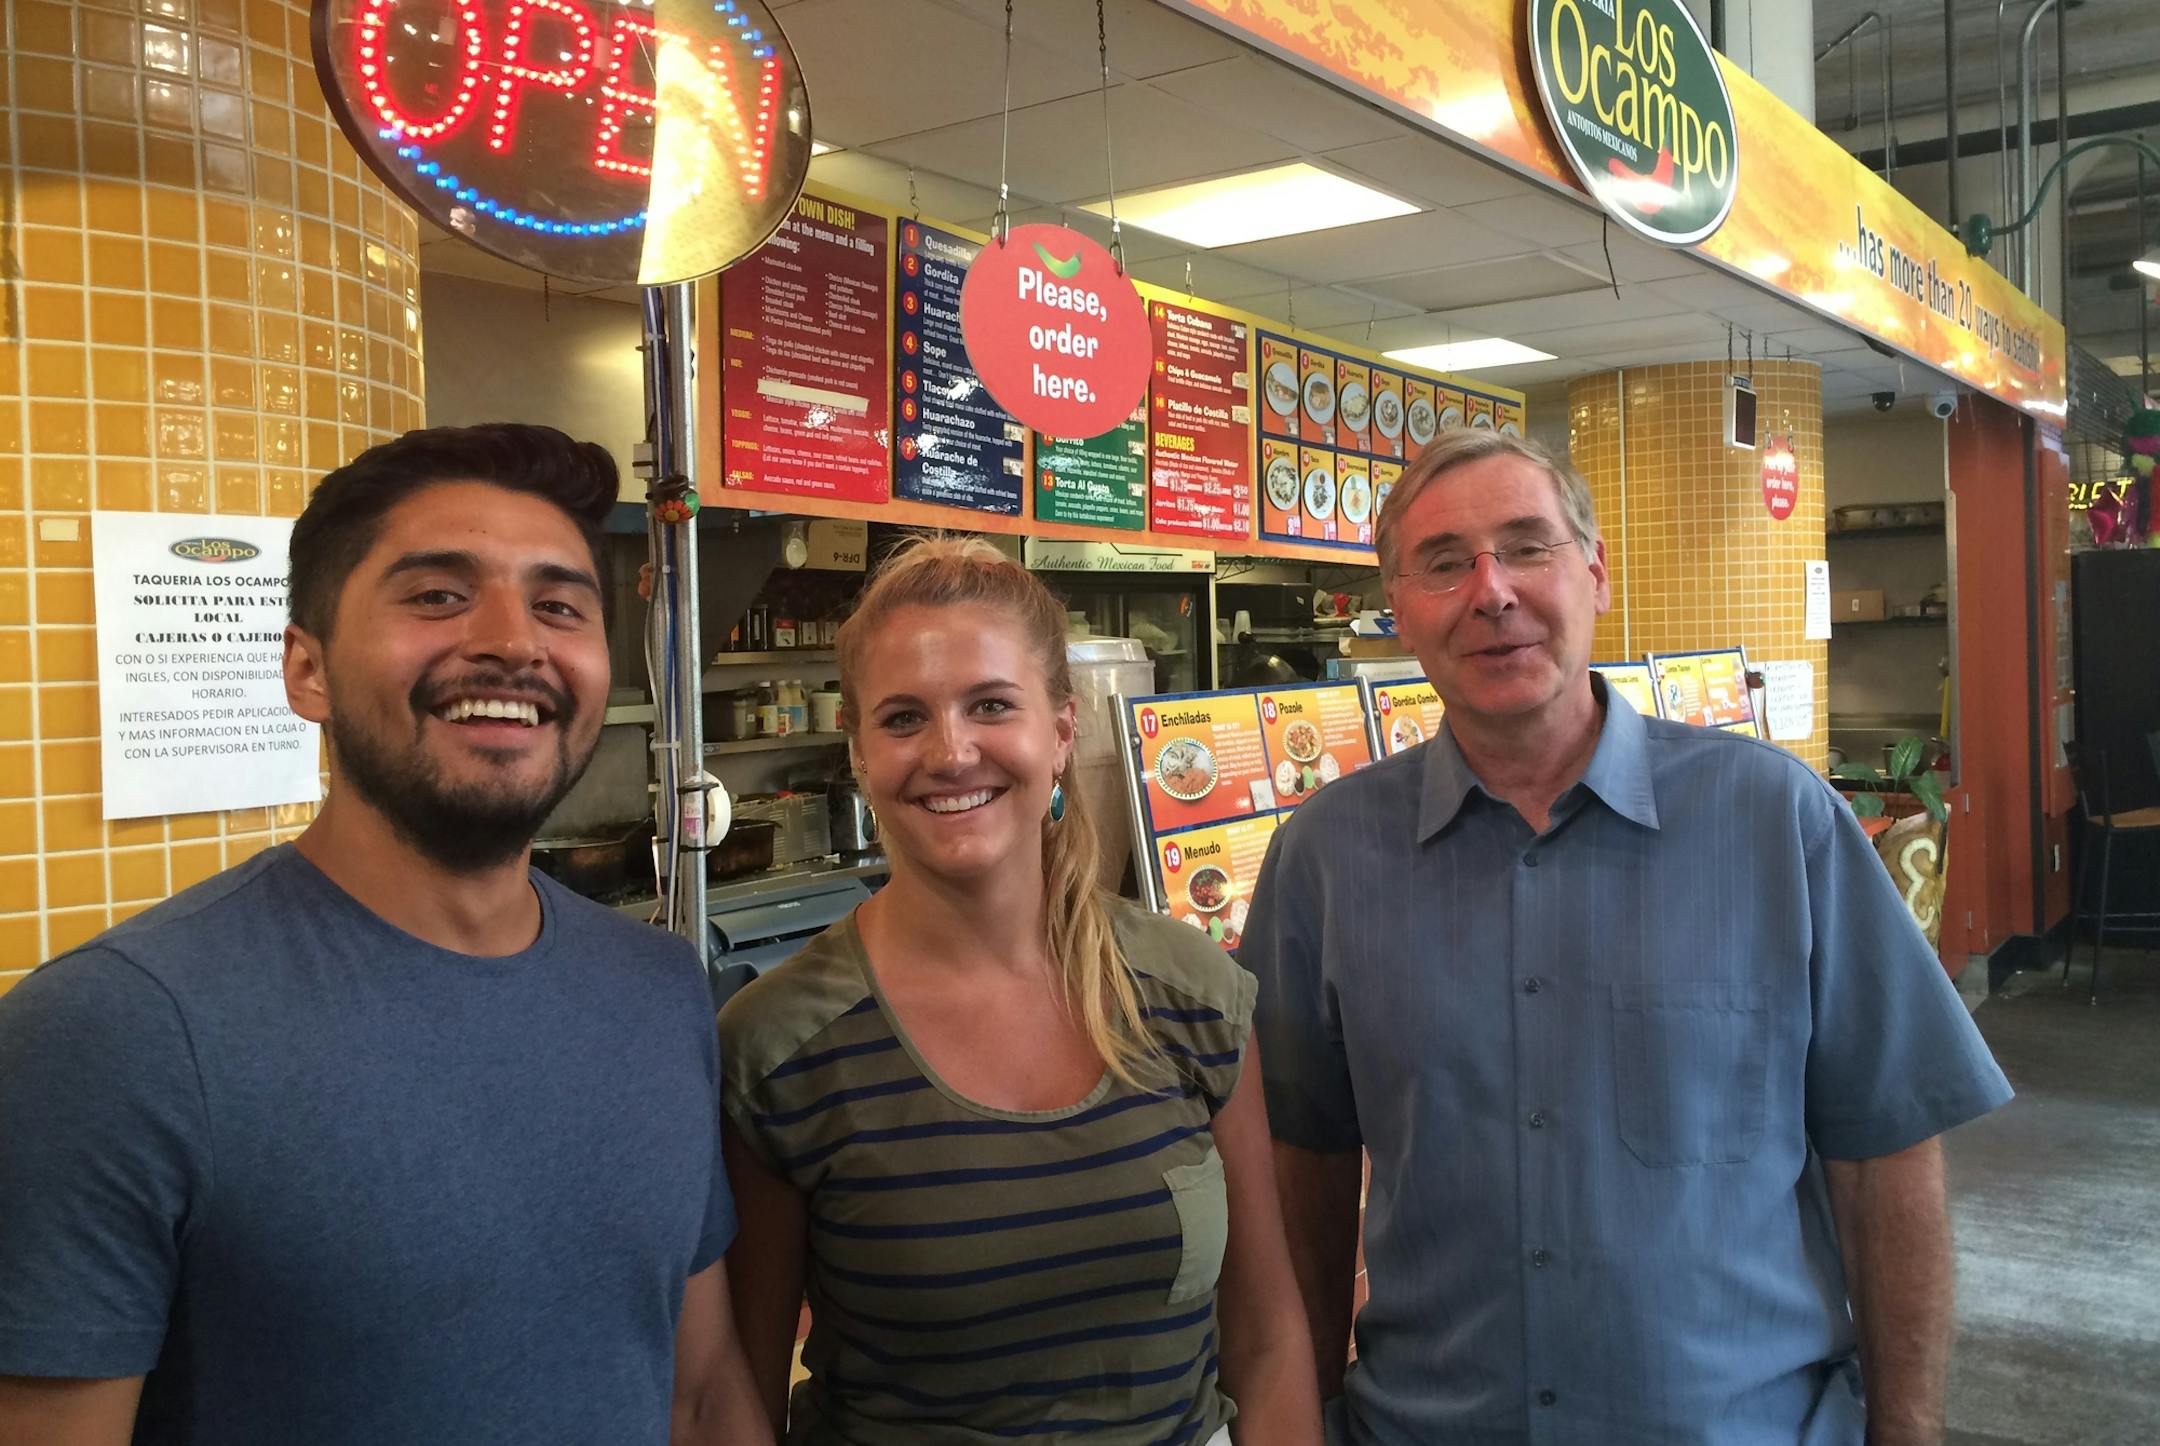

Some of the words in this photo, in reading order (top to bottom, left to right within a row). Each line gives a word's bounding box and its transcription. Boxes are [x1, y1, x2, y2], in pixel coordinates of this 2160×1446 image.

[1615, 0, 1676, 88] Los
[359, 0, 782, 200] OPEN
[1550, 0, 1728, 198] Ocampo
[1566, 109, 1604, 142] ANTOJITOS
[1602, 128, 1638, 163] MEXICANOS
[799, 197, 825, 222] OWN
[827, 206, 855, 231] DISH!
[792, 221, 801, 233] at
[801, 222, 814, 237] the
[814, 227, 834, 243] menu
[835, 232, 848, 248] and
[855, 237, 875, 257] filling
[924, 234, 972, 260] Quesadilla
[908, 257, 914, 270] 2
[924, 263, 959, 285] Gordita
[1018, 267, 1107, 322] Please,
[1889, 245, 1924, 304] more
[1927, 259, 1955, 321] than
[1958, 279, 1972, 331] 20
[1974, 303, 2000, 359] ways
[2001, 314, 2011, 357] to
[907, 296, 914, 310] 3
[923, 302, 960, 323] Huarach
[1155, 305, 1165, 318] 14
[1167, 309, 1186, 323] Torta
[1186, 314, 1213, 330] Cubana
[906, 335, 913, 349] 4
[923, 341, 947, 359] Sope
[1029, 323, 1098, 359] order
[906, 376, 912, 388] 5
[1033, 363, 1096, 404] here.
[1167, 364, 1184, 377] Chips
[1190, 369, 1222, 385] Guacamole
[906, 403, 912, 416] 6
[922, 407, 976, 430] Huarachazo
[1167, 399, 1192, 413] Platillo
[1193, 404, 1202, 415] de
[1203, 406, 1229, 420] Costilla
[1154, 432, 1195, 452] BEVERAGES
[966, 454, 978, 467] de
[1155, 449, 1180, 460] Authentic
[1043, 475, 1053, 487] 13
[1055, 476, 1076, 489] Torta
[1077, 480, 1086, 490] Al
[174, 543, 259, 559] Ocampo
[201, 537, 230, 550] Los
[1031, 553, 1093, 570] Authentic
[1096, 555, 1145, 571] Mexican
[1149, 556, 1175, 571] Food
[133, 574, 202, 587] TAQUERIA
[206, 575, 231, 587] LOS
[235, 576, 290, 588] OCAMPO
[133, 594, 209, 607] SOLICITA
[213, 595, 256, 607] PARA
[194, 612, 244, 624] LOCAL
[135, 631, 208, 644] CAJERAS
[211, 631, 222, 643] O
[115, 653, 143, 666] CON
[145, 653, 155, 665] O
[156, 653, 168, 665] SI
[171, 651, 245, 664] EXPERIENCIA
[247, 652, 269, 664] QUE
[125, 671, 171, 684] INGLES,
[173, 671, 199, 683] CON
[191, 687, 247, 700] HORARIO.
[1392, 695, 1417, 708] Gordita
[1417, 693, 1439, 706] Combo
[119, 710, 200, 723] INTERESADOS
[202, 708, 235, 721] PEDIR
[1263, 701, 1276, 719] 18
[1279, 701, 1303, 715] Pozole
[118, 730, 126, 742] Y
[128, 729, 157, 741] MAS
[159, 726, 242, 740] INFORMACION
[244, 725, 259, 737] EN
[261, 724, 275, 736] LA
[275, 723, 298, 734] CAJA
[298, 722, 307, 732] O
[1142, 714, 1157, 733] 17
[1160, 711, 1212, 728] Enchiladas
[124, 747, 153, 760] CON
[154, 746, 169, 759] LA
[171, 742, 249, 758] SUPERVISORA
[251, 741, 266, 753] EN
[267, 740, 302, 752] TURNO.
[1165, 849, 1179, 868] 19
[1184, 841, 1221, 860] Menudo
